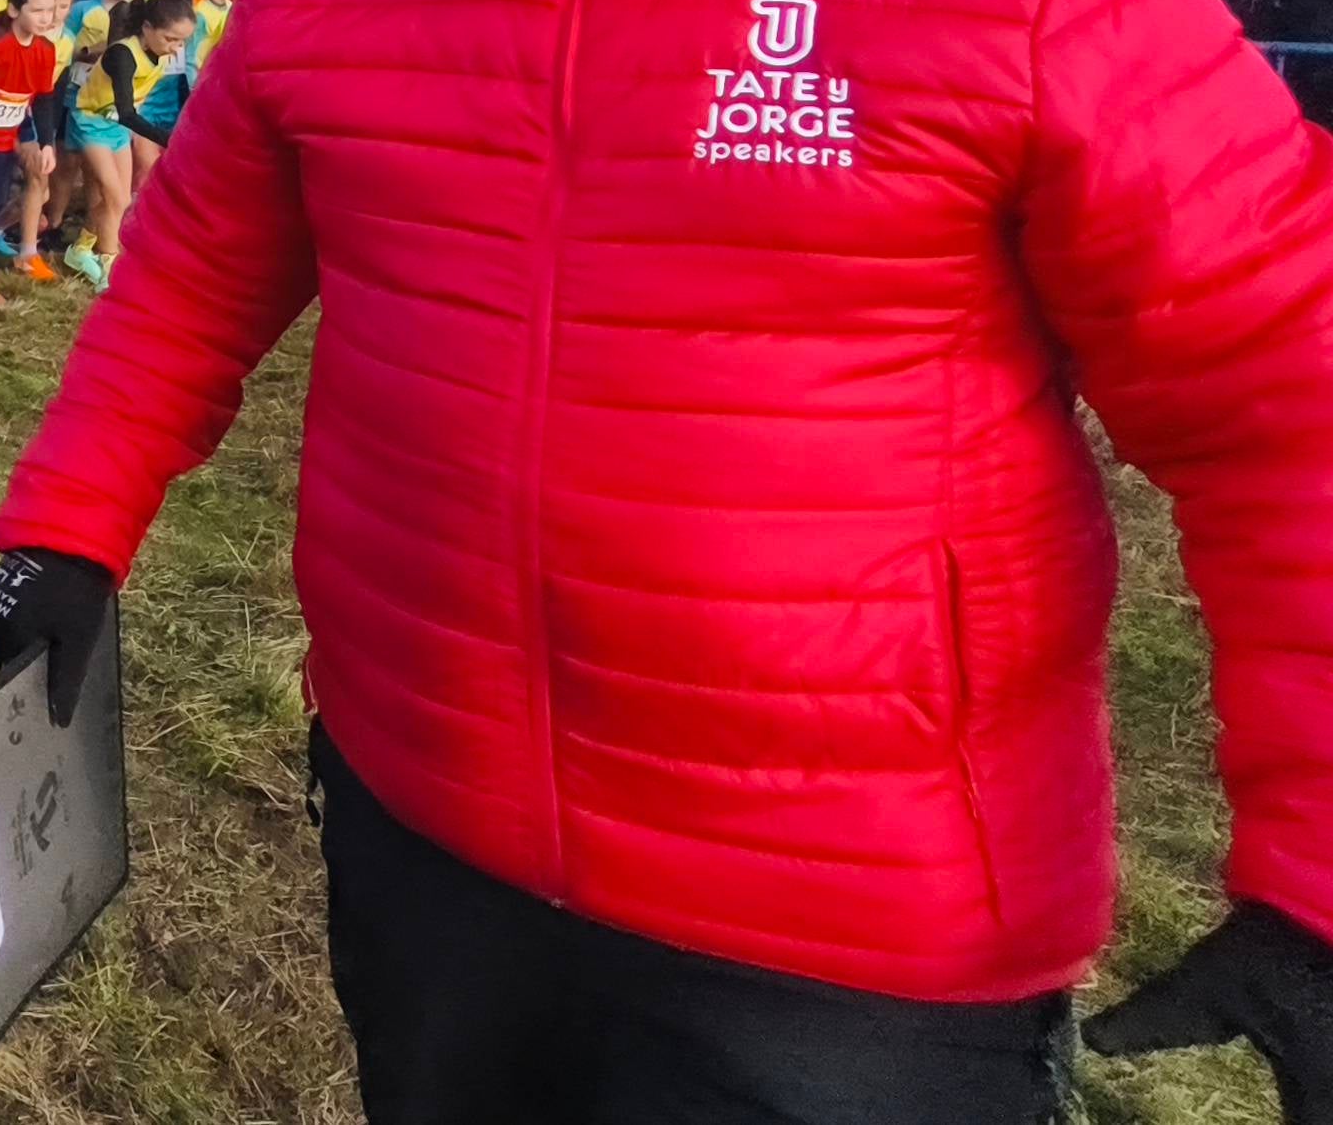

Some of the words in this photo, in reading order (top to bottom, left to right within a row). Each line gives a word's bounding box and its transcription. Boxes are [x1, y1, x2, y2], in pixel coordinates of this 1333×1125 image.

[704, 68, 820, 101] TATE
[826, 77, 849, 104] y
[694, 101, 855, 139] JORGE
[692, 140, 853, 167] speakers
